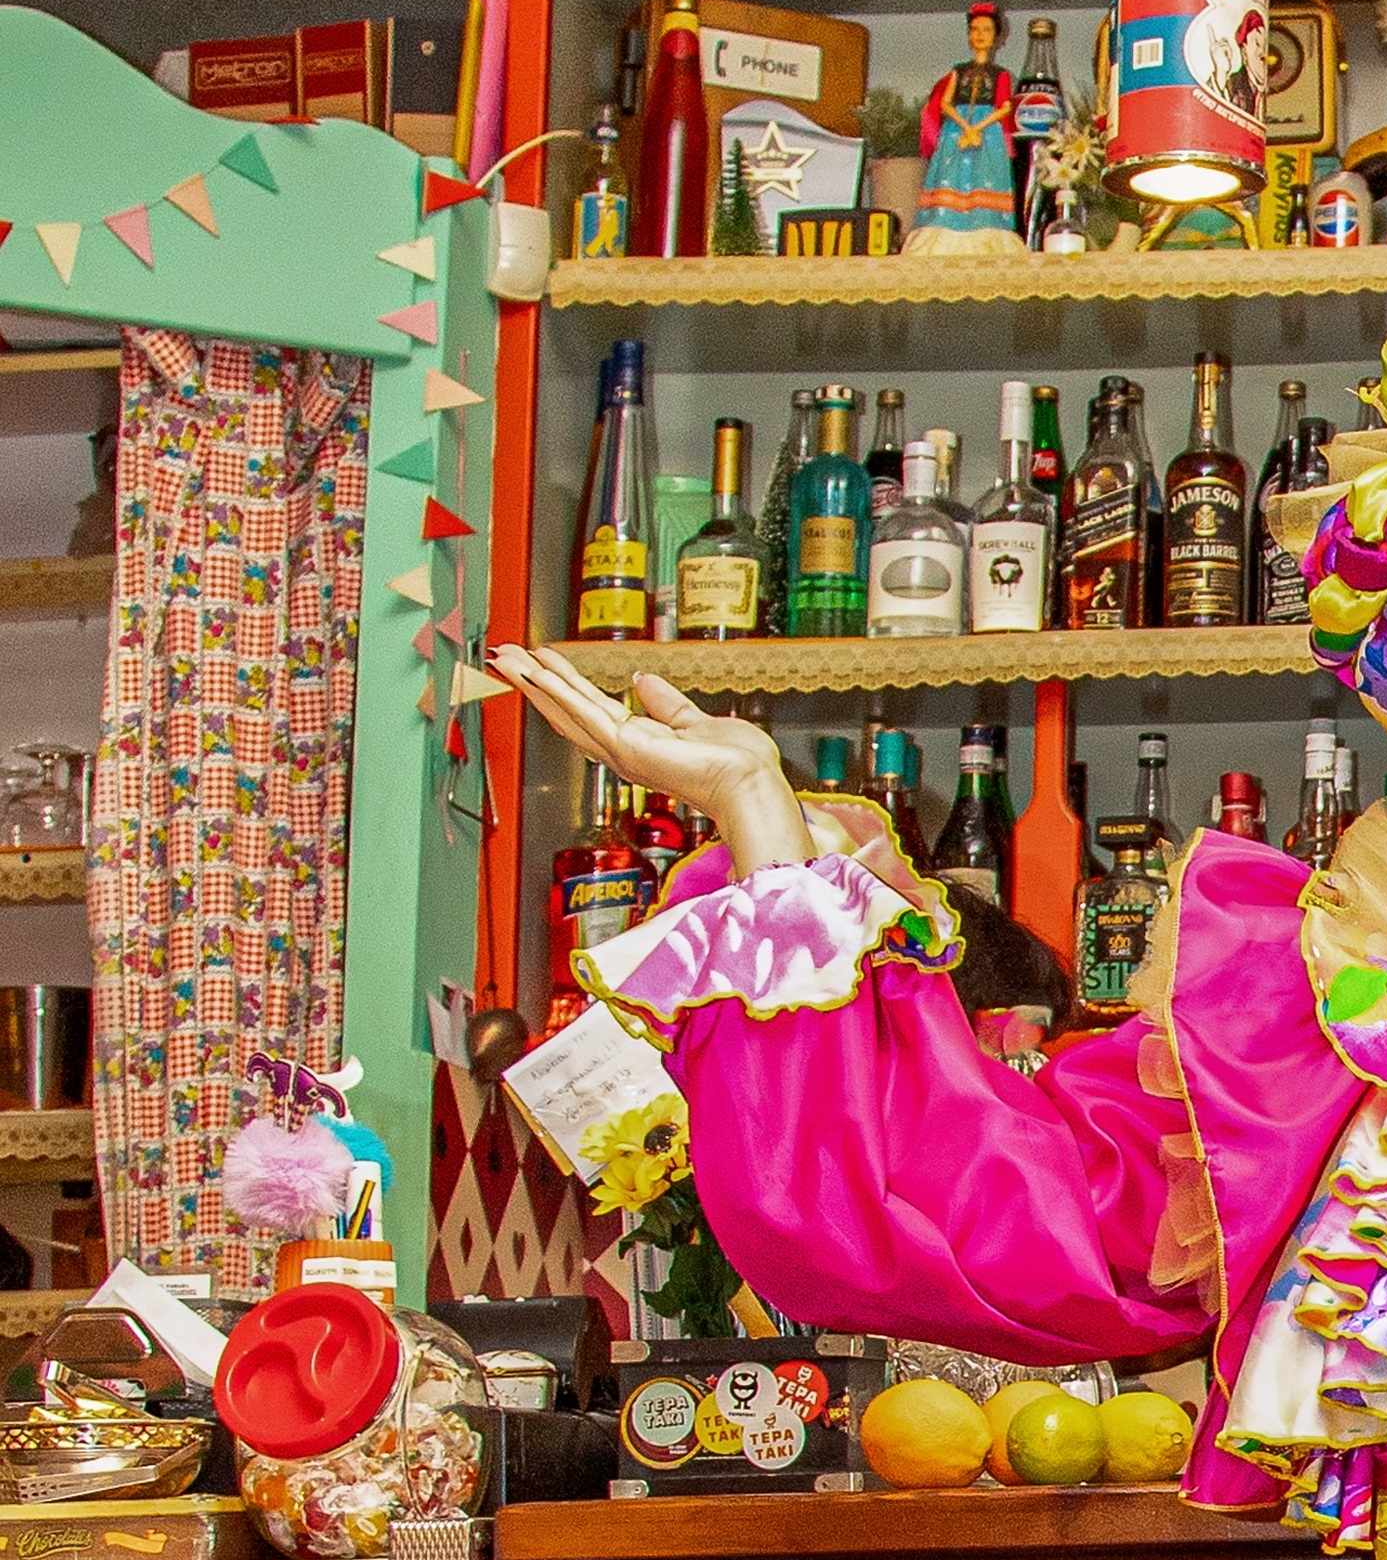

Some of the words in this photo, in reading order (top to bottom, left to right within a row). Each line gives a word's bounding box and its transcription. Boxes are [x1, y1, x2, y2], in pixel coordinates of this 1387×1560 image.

[740, 54, 799, 78] PHONE
[1169, 486, 1240, 513] JAMESON
[1170, 545, 1199, 561] BLACK
[1202, 544, 1239, 560] BARREL
[1095, 612, 1110, 625] 12
[569, 879, 635, 908] APEROL
[17, 1527, 92, 1558] Chocolates
